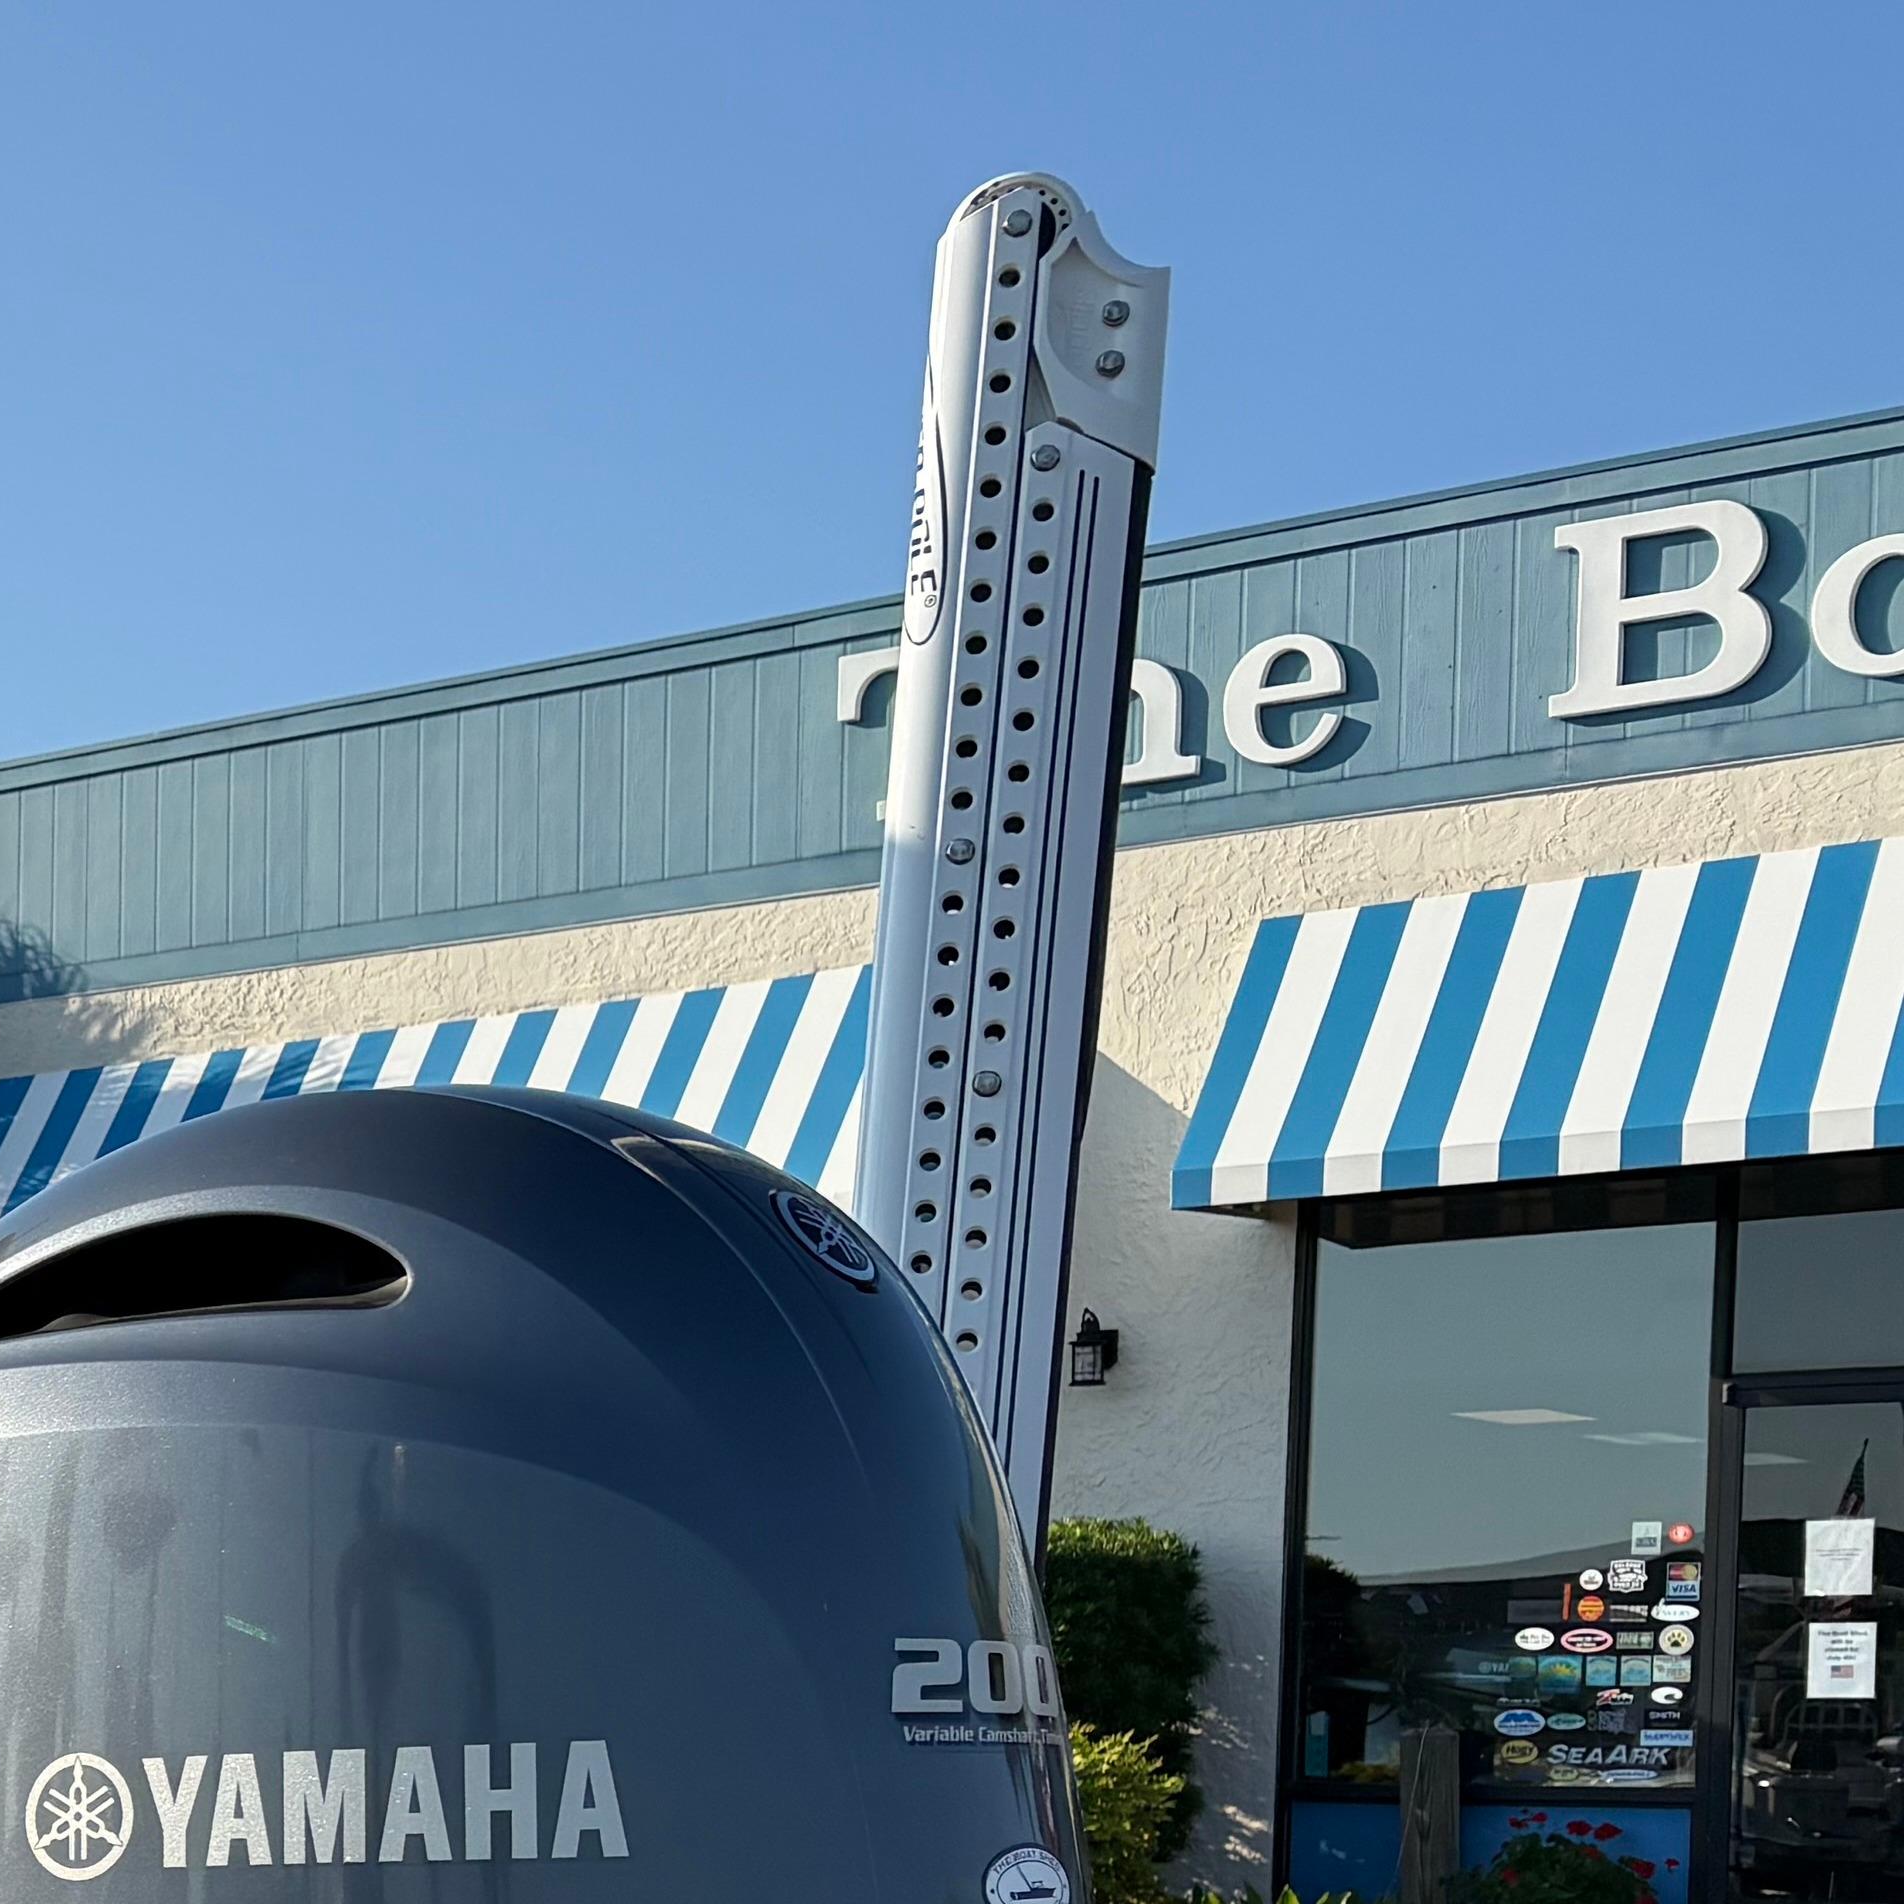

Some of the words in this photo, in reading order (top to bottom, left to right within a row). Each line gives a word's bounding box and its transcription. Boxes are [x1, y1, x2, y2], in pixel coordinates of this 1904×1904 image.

[1671, 1583, 1697, 1594] VISA
[892, 1638, 1060, 1717] 200
[903, 1726, 974, 1743] Variable
[142, 1740, 630, 1868] YAMAHA
